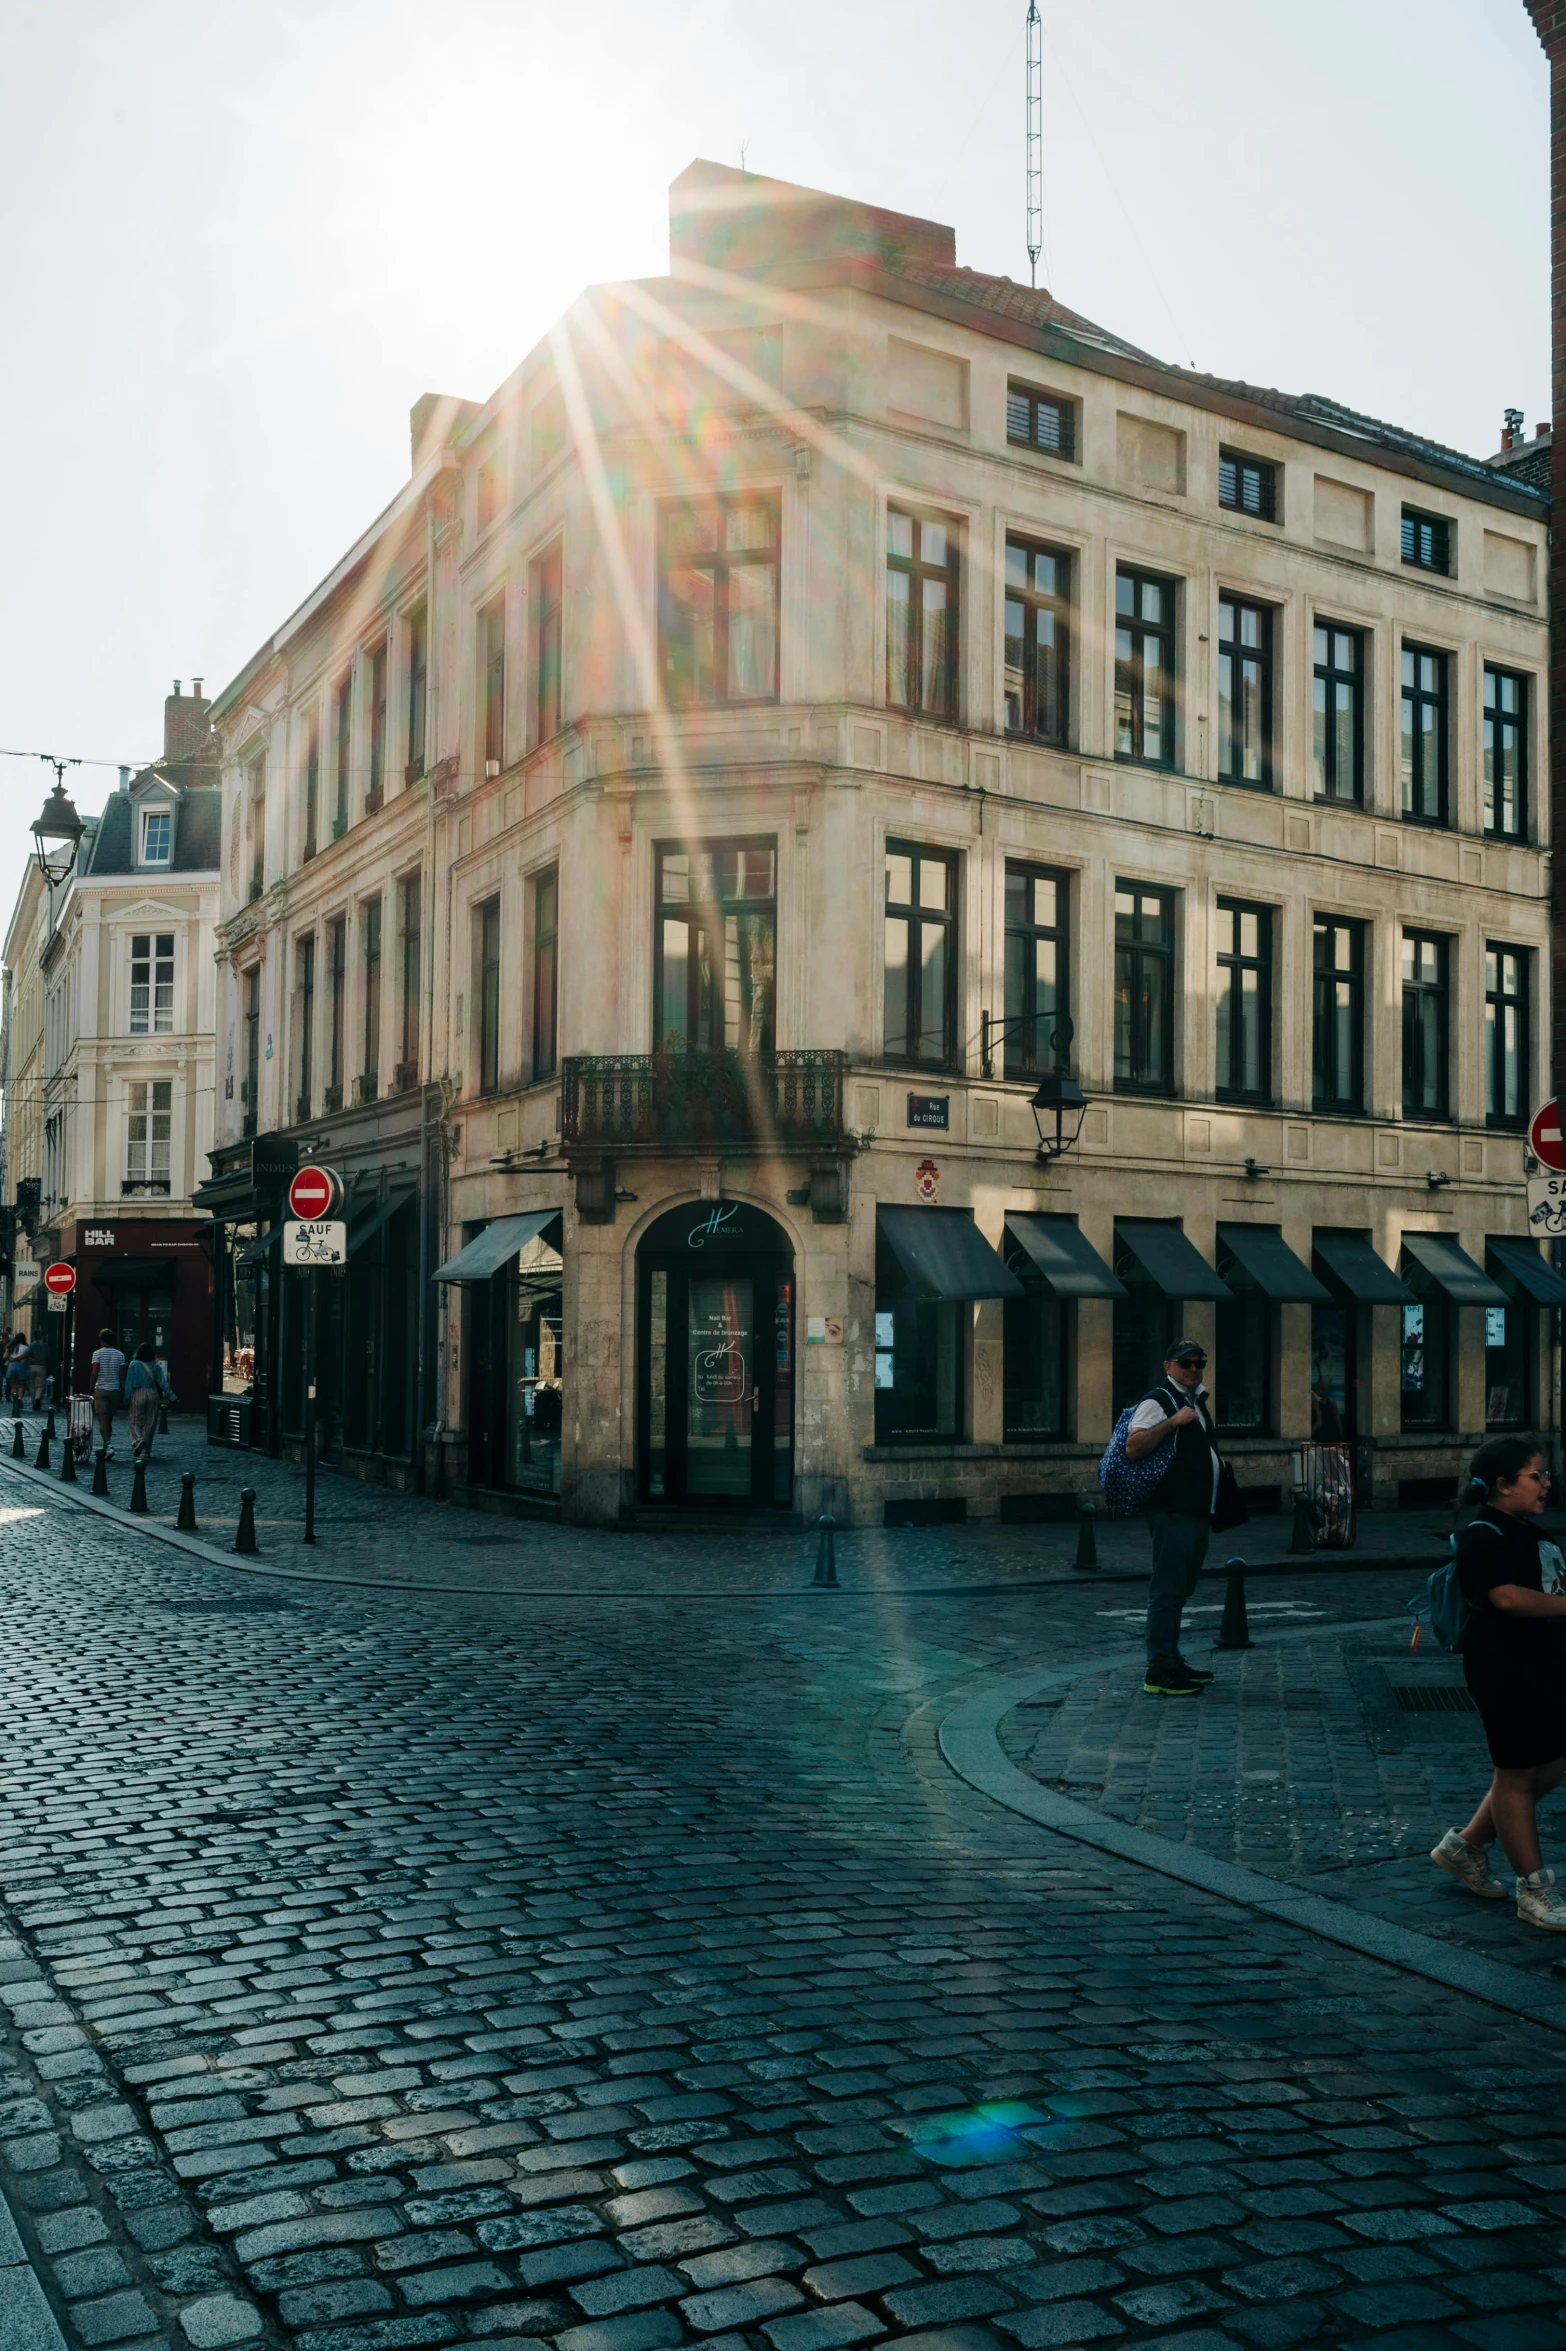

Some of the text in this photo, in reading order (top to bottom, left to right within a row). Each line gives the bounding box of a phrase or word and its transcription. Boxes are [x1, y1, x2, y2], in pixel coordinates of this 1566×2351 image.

[929, 1102, 940, 1111] Rue
[914, 1114, 920, 1122] du
[256, 1163, 296, 1173] INDIES
[84, 1230, 115, 1238] HILL
[84, 1238, 115, 1246] BAR
